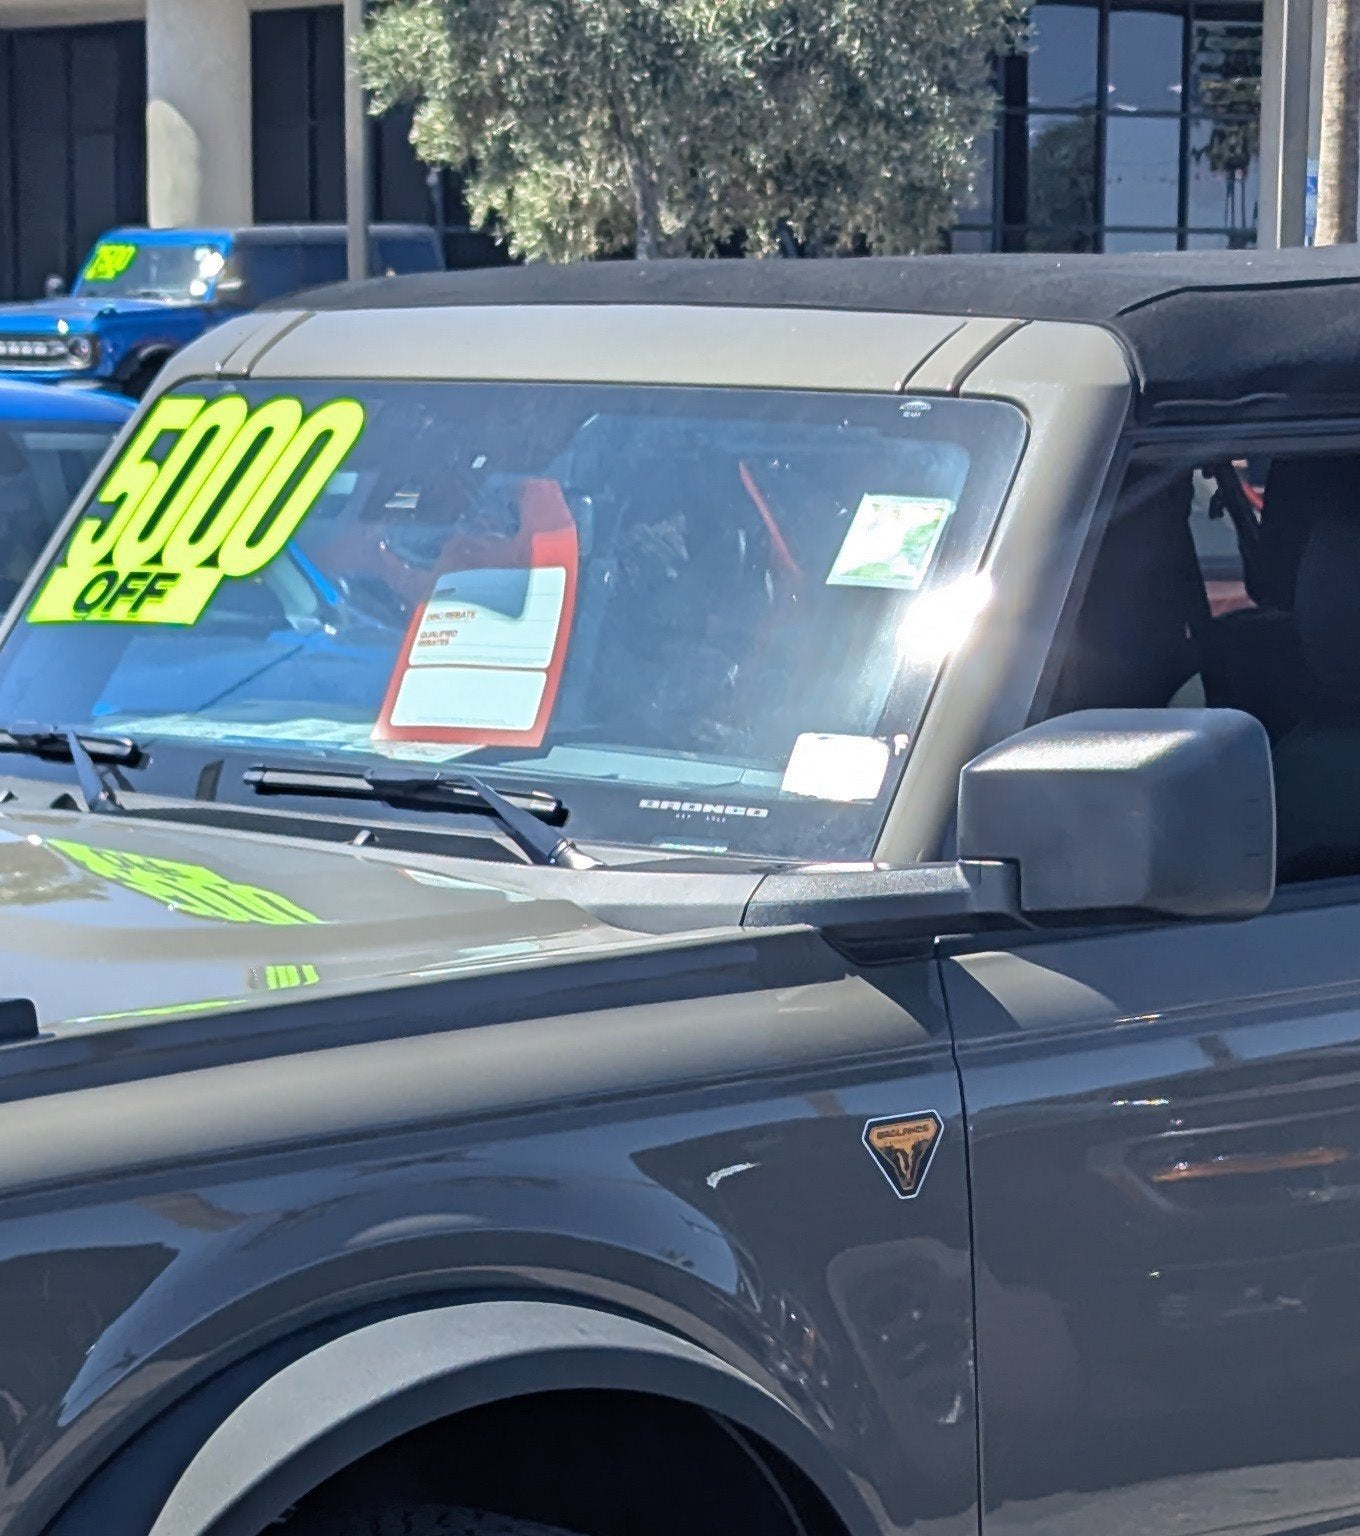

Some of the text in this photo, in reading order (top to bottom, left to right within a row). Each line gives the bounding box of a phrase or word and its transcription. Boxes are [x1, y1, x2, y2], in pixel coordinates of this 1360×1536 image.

[67, 394, 364, 577] 5000
[72, 569, 182, 617] OFF
[639, 799, 769, 818] BRONCO
